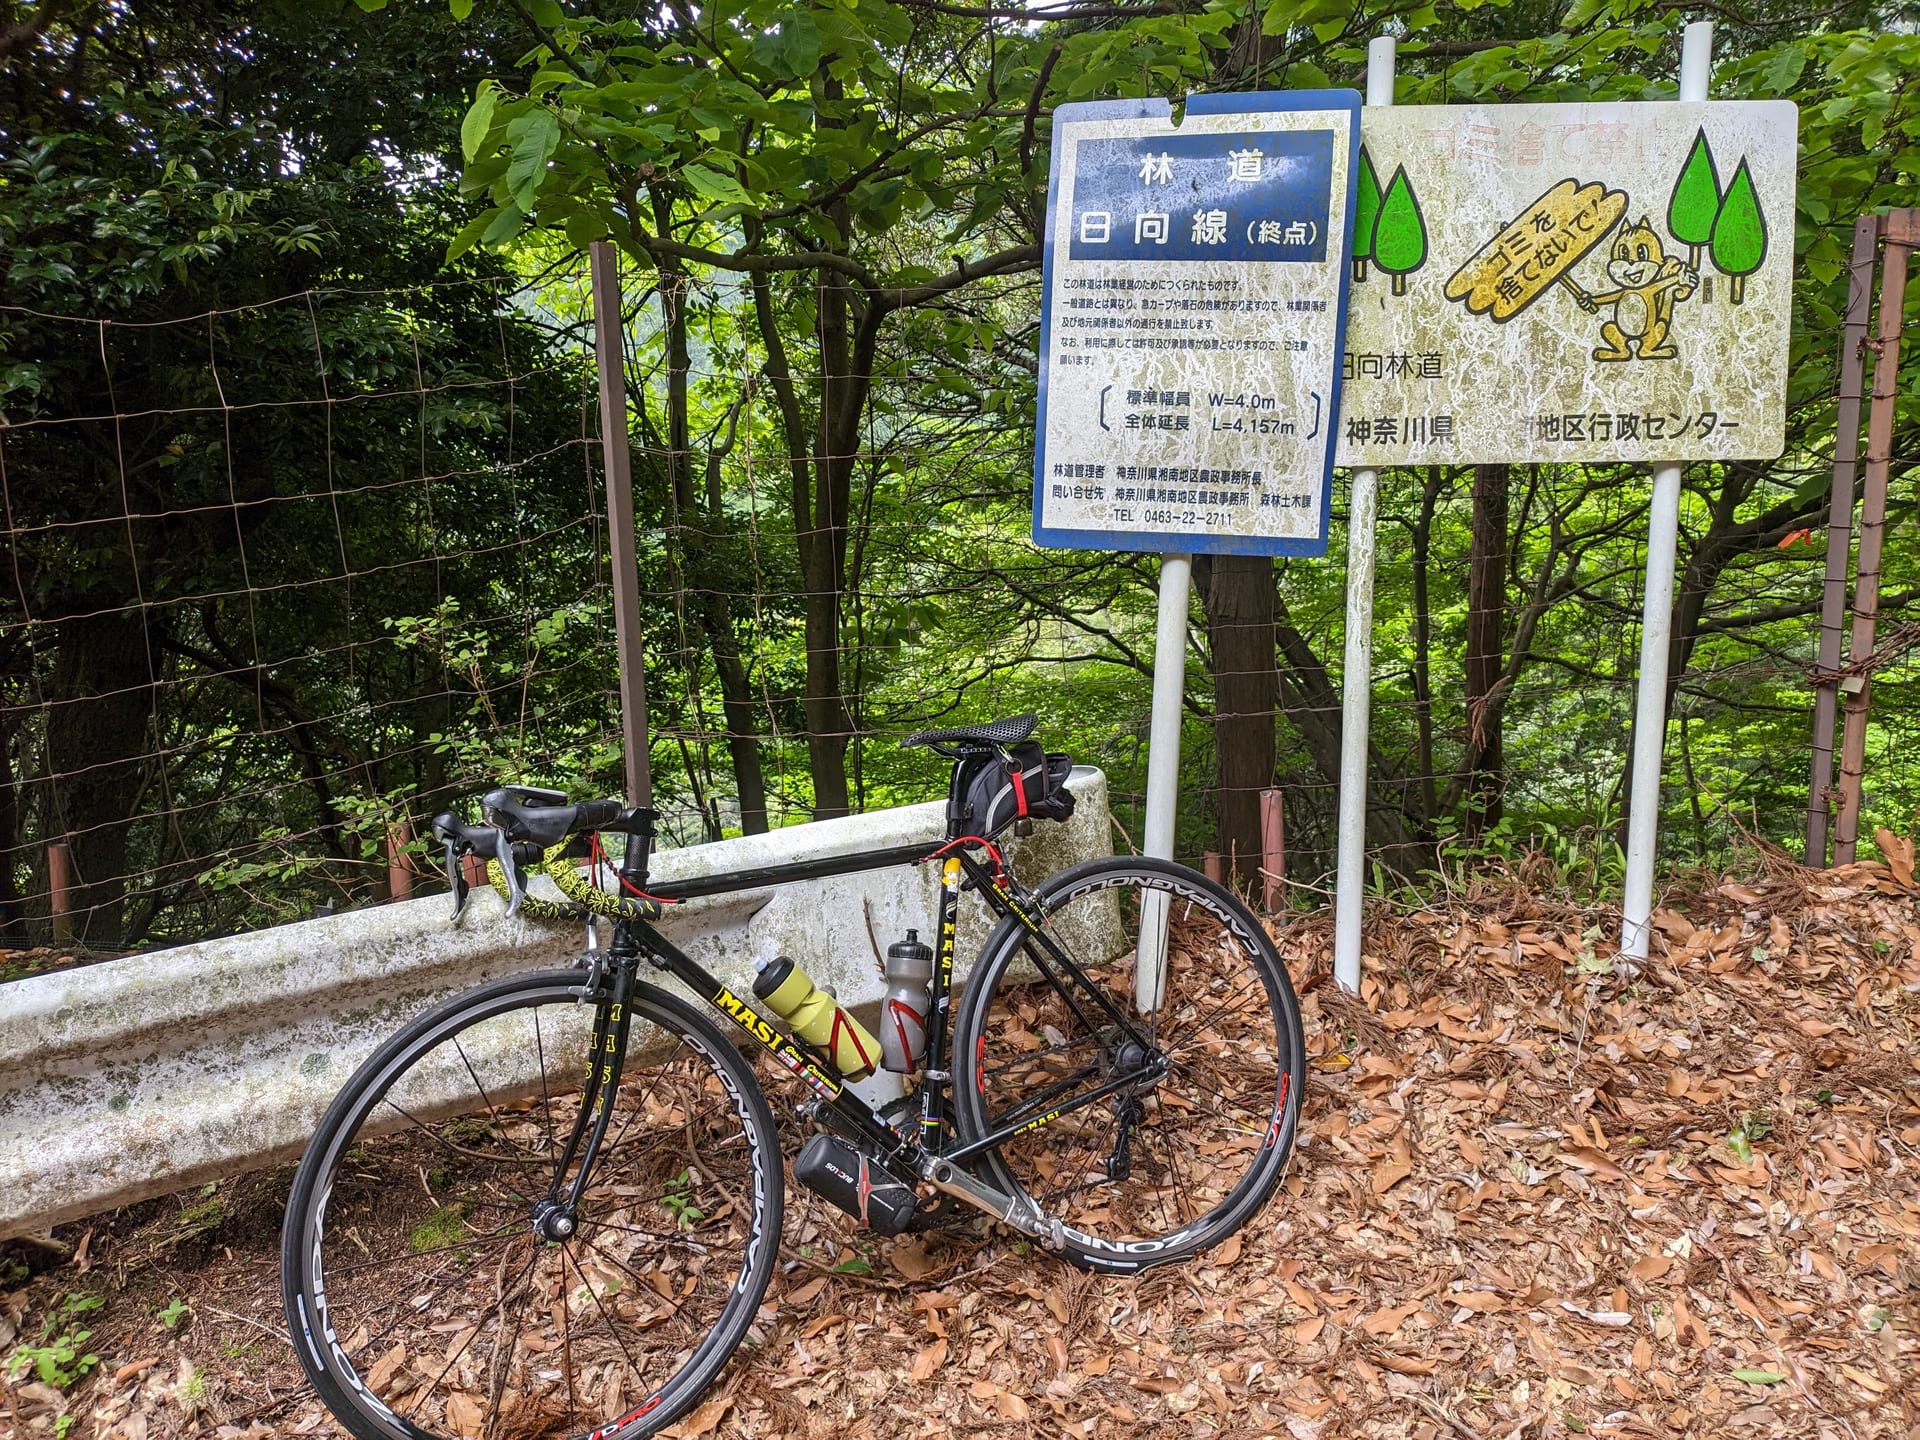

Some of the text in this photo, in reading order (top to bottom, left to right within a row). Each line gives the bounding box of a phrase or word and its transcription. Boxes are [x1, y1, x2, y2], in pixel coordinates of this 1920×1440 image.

[1139, 148, 1264, 185] 林道
[1487, 209, 1556, 276] ゴミを
[1126, 389, 1276, 410] 標準幅員 W=4.0m
[1125, 414, 1295, 435] 全体延長 L=4,157m
[1346, 415, 1454, 446] 神奈川県
[1053, 463, 1105, 480] 林道管理者
[1052, 484, 1105, 501] 問い合せ先
[1114, 508, 1233, 526] TEL 0463-22-2711
[1070, 876, 1260, 956] CAMPAGNOLO
[941, 922, 956, 987] MASI
[716, 990, 784, 1051] MASI
[1028, 1110, 1060, 1130] MASI
[681, 1033, 766, 1295] CAMPAGNOLO
[312, 1184, 394, 1422] ZONDA
